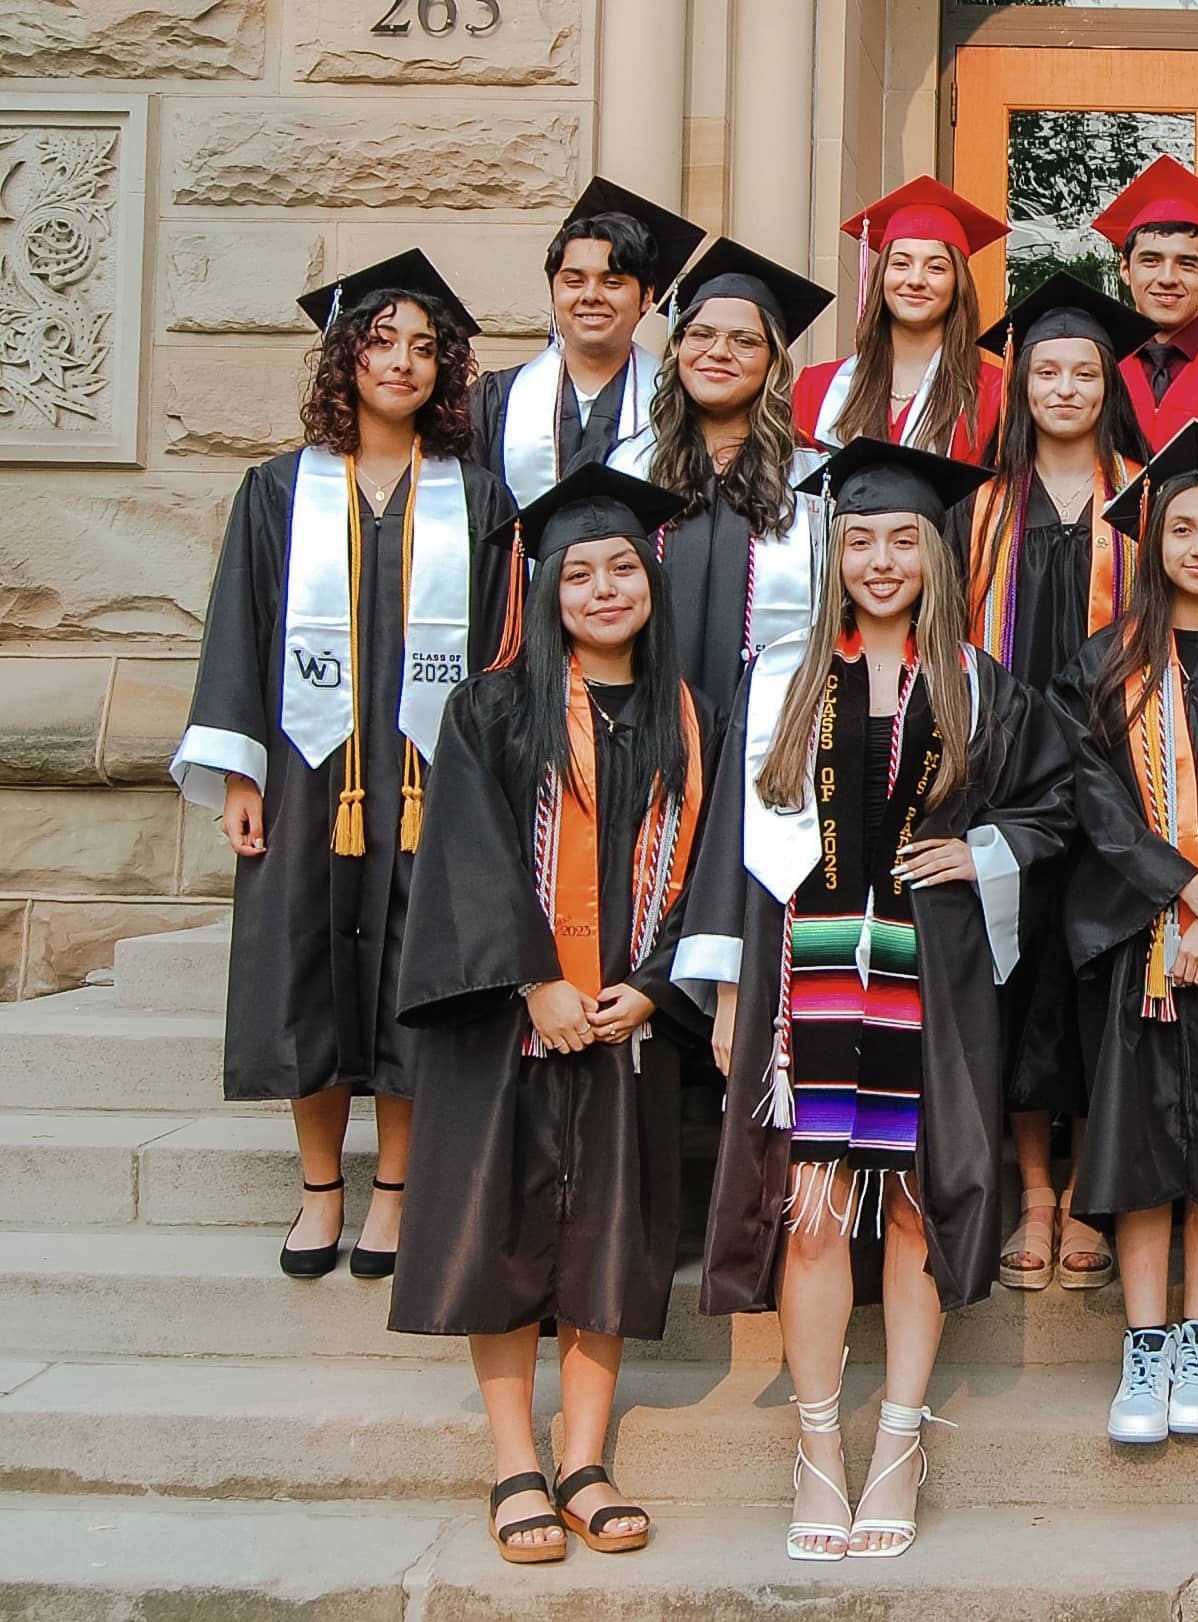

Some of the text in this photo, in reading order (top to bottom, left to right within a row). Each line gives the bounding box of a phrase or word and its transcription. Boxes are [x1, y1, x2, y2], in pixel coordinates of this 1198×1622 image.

[412, 652, 462, 662] CLASS OF
[412, 662, 462, 684] 2023
[820, 673, 839, 891] CLASS OF 2023
[916, 750, 941, 796] MIS
